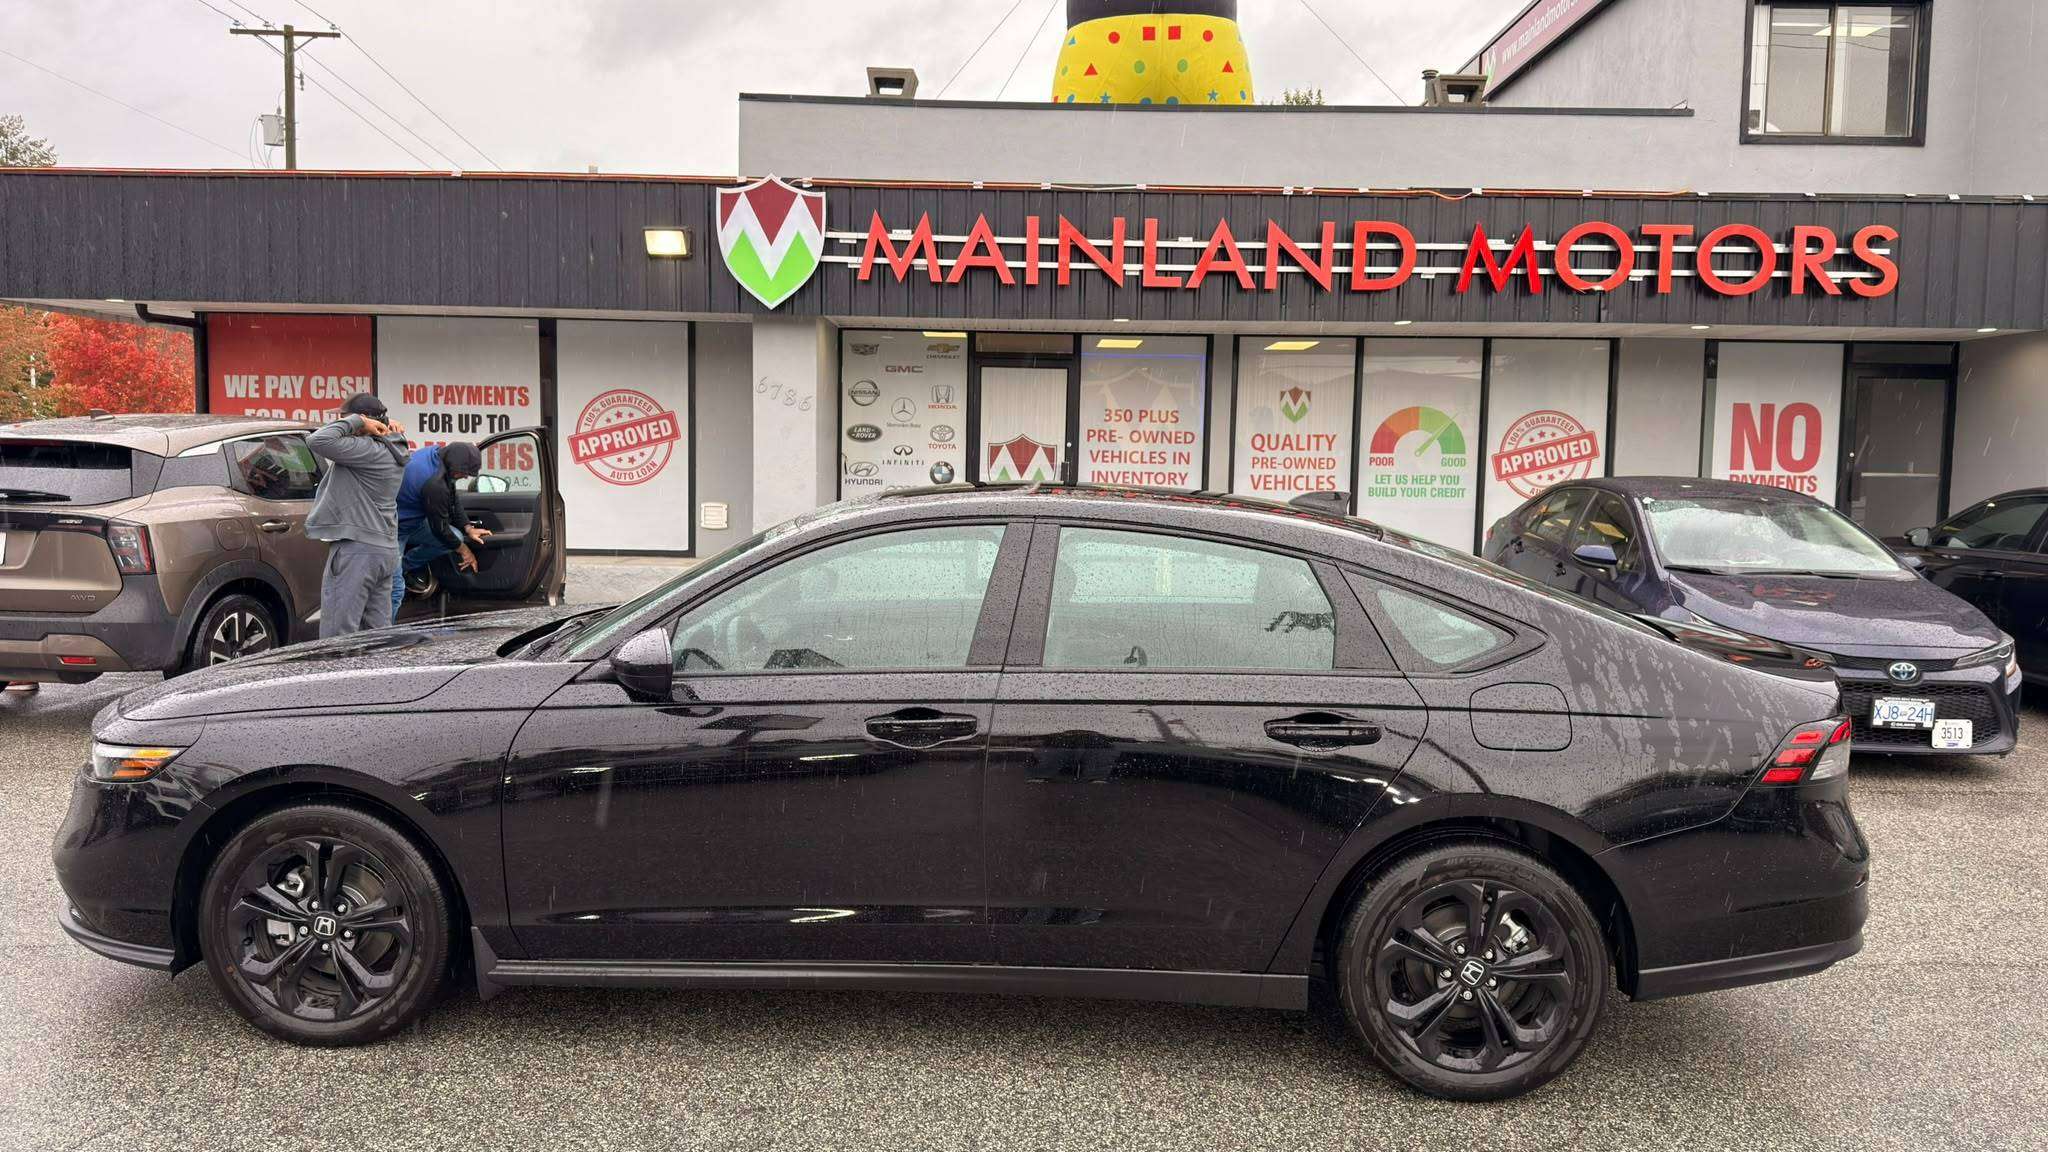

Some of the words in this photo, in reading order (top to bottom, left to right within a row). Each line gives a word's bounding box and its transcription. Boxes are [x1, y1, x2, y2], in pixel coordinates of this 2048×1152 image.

[857, 208, 1417, 293] MAINLAND
[1455, 221, 1899, 297] MOTORS
[885, 365, 923, 373] GMC
[224, 375, 259, 399] WE
[265, 375, 305, 399] PAY
[310, 376, 370, 400] CASH
[402, 384, 428, 405] NO
[433, 385, 530, 407] PAYMENTS
[756, 376, 812, 412] 6786
[600, 394, 654, 413] GUARANTEED
[418, 413, 453, 433] FOR
[458, 414, 482, 433] UP
[487, 414, 510, 433] TO
[1103, 409, 1133, 423] 350
[1138, 410, 1180, 424] PLUS
[1524, 416, 1575, 433] GUARANTEED
[578, 419, 673, 457] APPROVED
[1087, 429, 1124, 443] PRE-
[1129, 430, 1196, 445] OWNED
[1250, 433, 1337, 453] QUALITY
[1730, 402, 1822, 473] NO
[1089, 450, 1167, 465] VEHICLES
[1173, 451, 1191, 465] IN
[1251, 456, 1336, 470] PRE-OWNED
[1368, 456, 1395, 467] POOR
[1440, 457, 1467, 467] GOOD
[1500, 438, 1592, 475] APPROVED
[609, 470, 634, 480] AUTO
[636, 460, 658, 478] LOAN
[1091, 470, 1189, 486] INVENTORY
[845, 478, 883, 486] HYUNDAI
[1250, 474, 1336, 491] VEHICLES
[1374, 474, 1393, 485] LET
[1395, 474, 1409, 485] US
[1411, 475, 1437, 485] HELP
[1439, 475, 1460, 486] YOU
[1368, 487, 1397, 498] BUILD
[1400, 487, 1428, 498] YOUR
[1429, 487, 1467, 499] CREDIT
[71, 592, 96, 601] AWD
[1941, 727, 1964, 740] 3513
